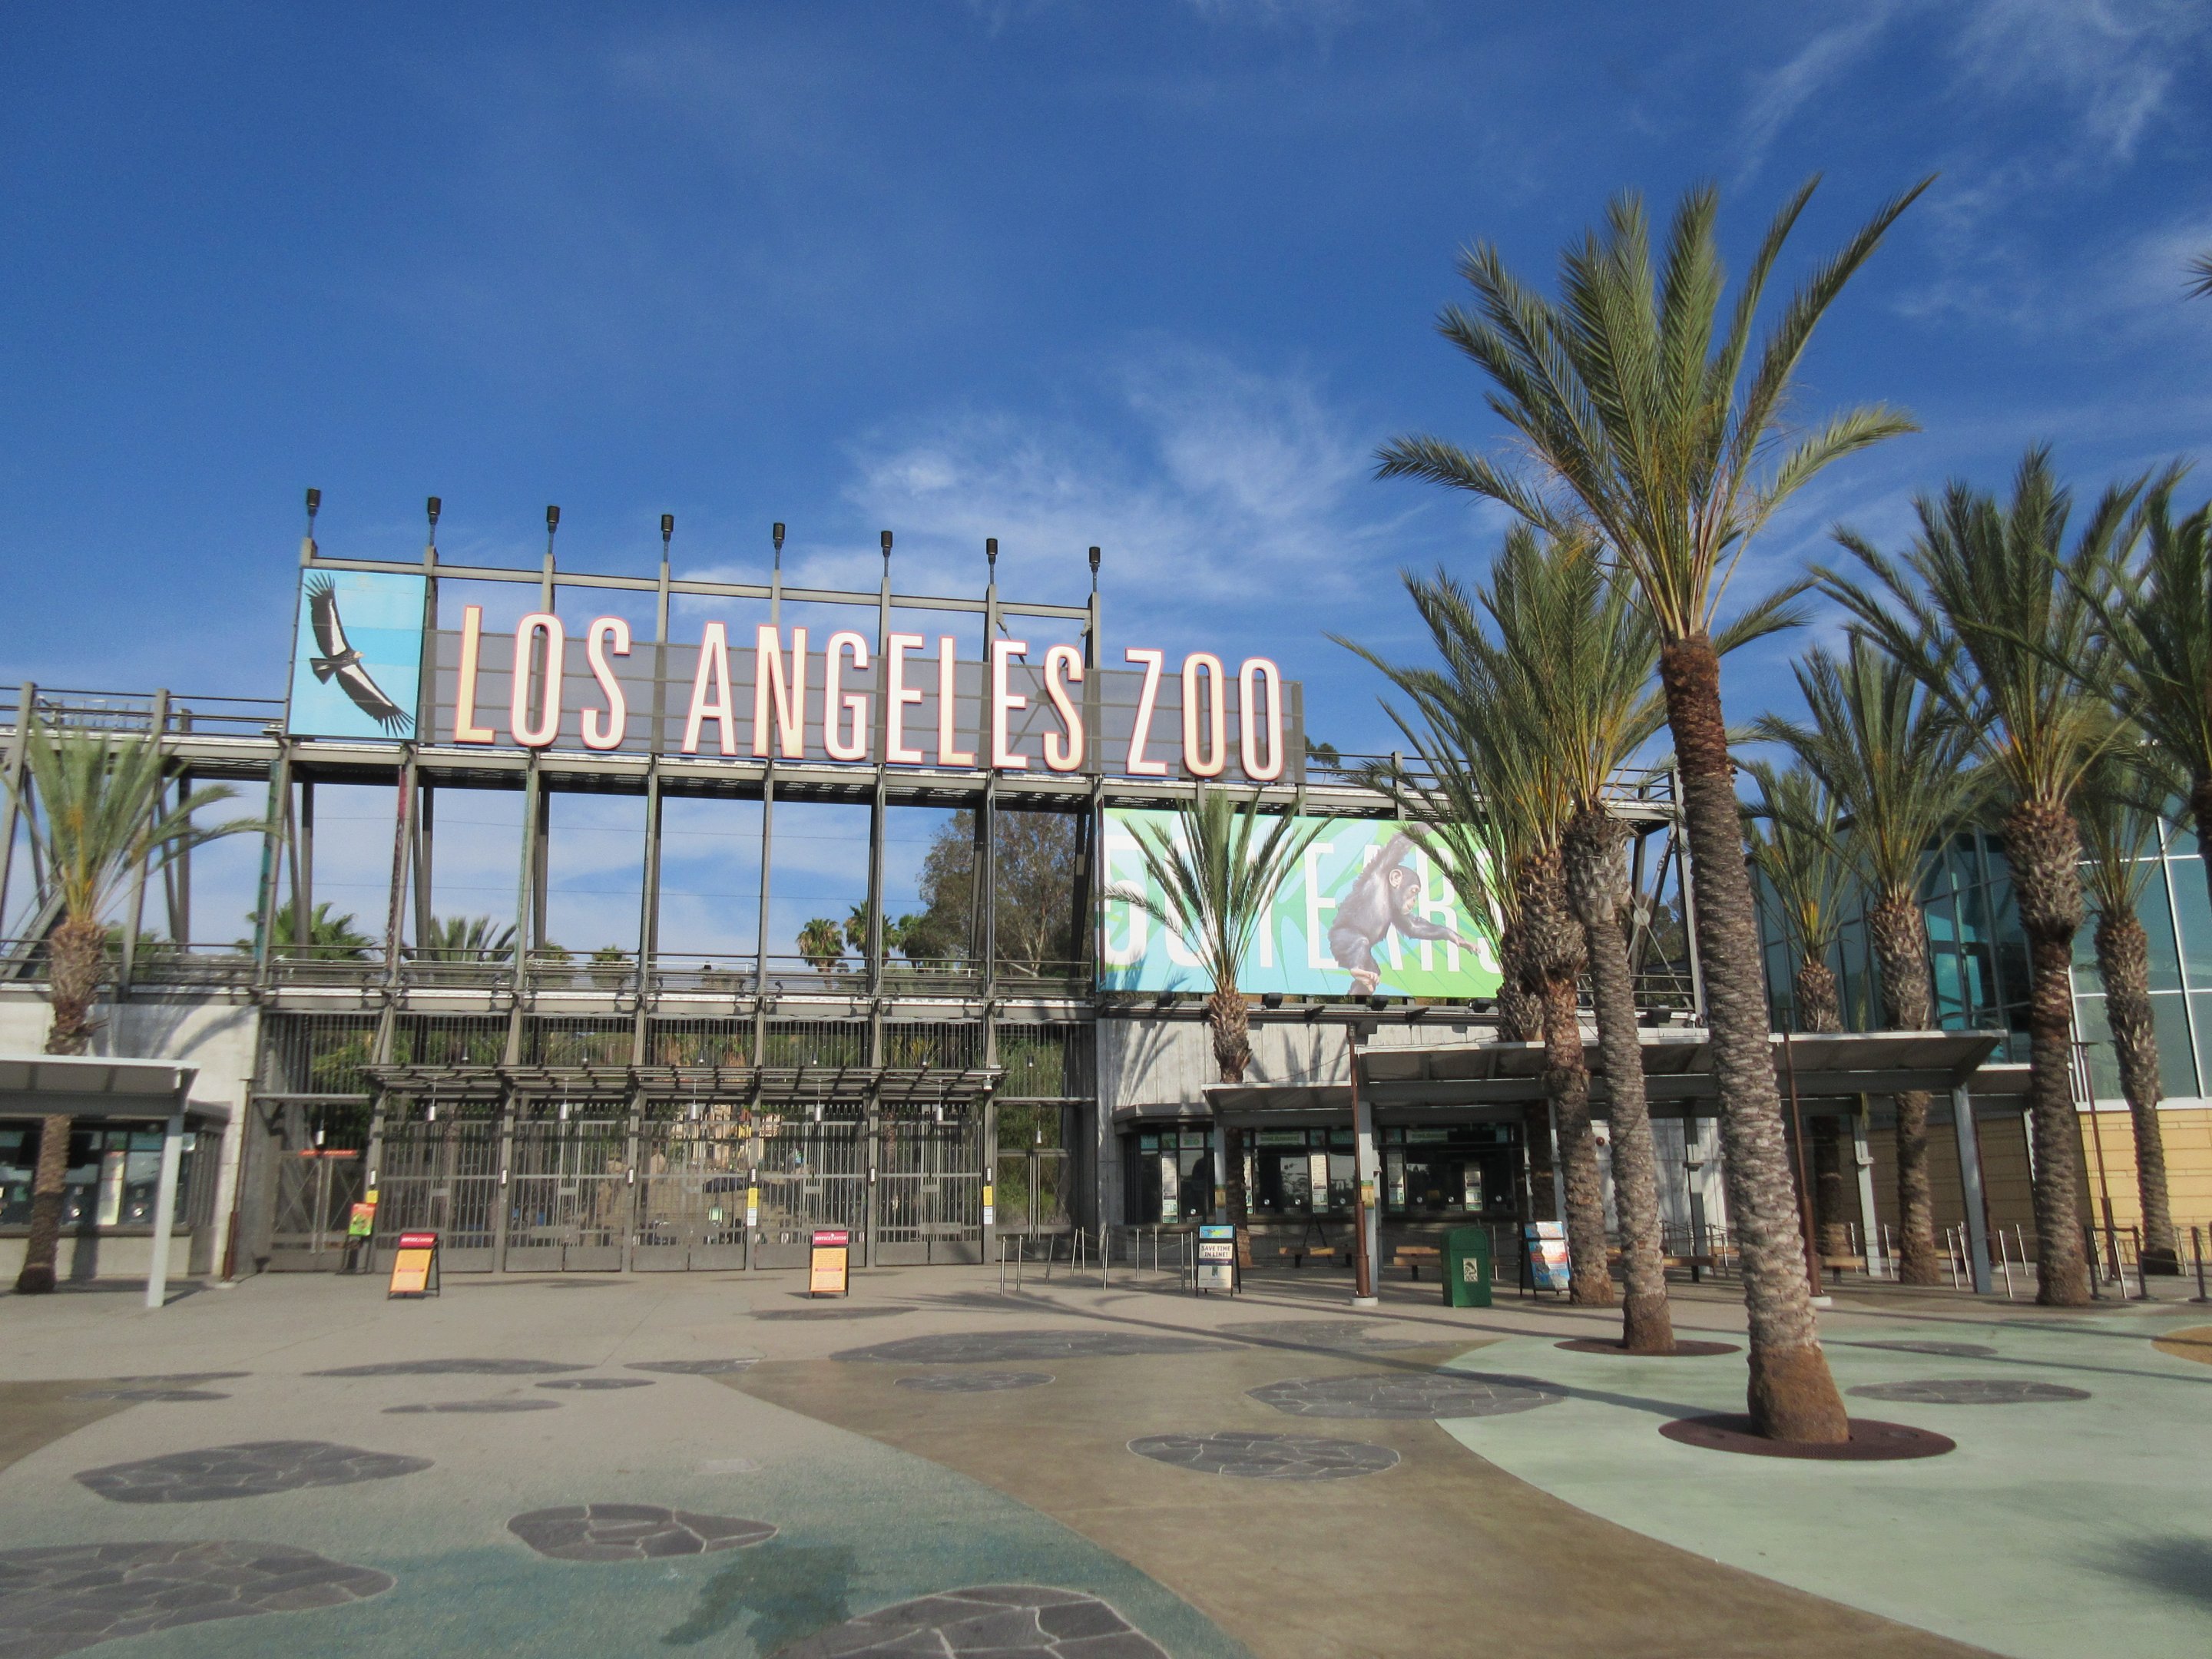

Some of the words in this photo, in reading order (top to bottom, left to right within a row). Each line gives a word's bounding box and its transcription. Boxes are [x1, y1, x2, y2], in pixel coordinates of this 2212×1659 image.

[453, 605, 631, 750] LOS
[681, 621, 1084, 772] ANGELES
[1124, 647, 1284, 781] ZOO
